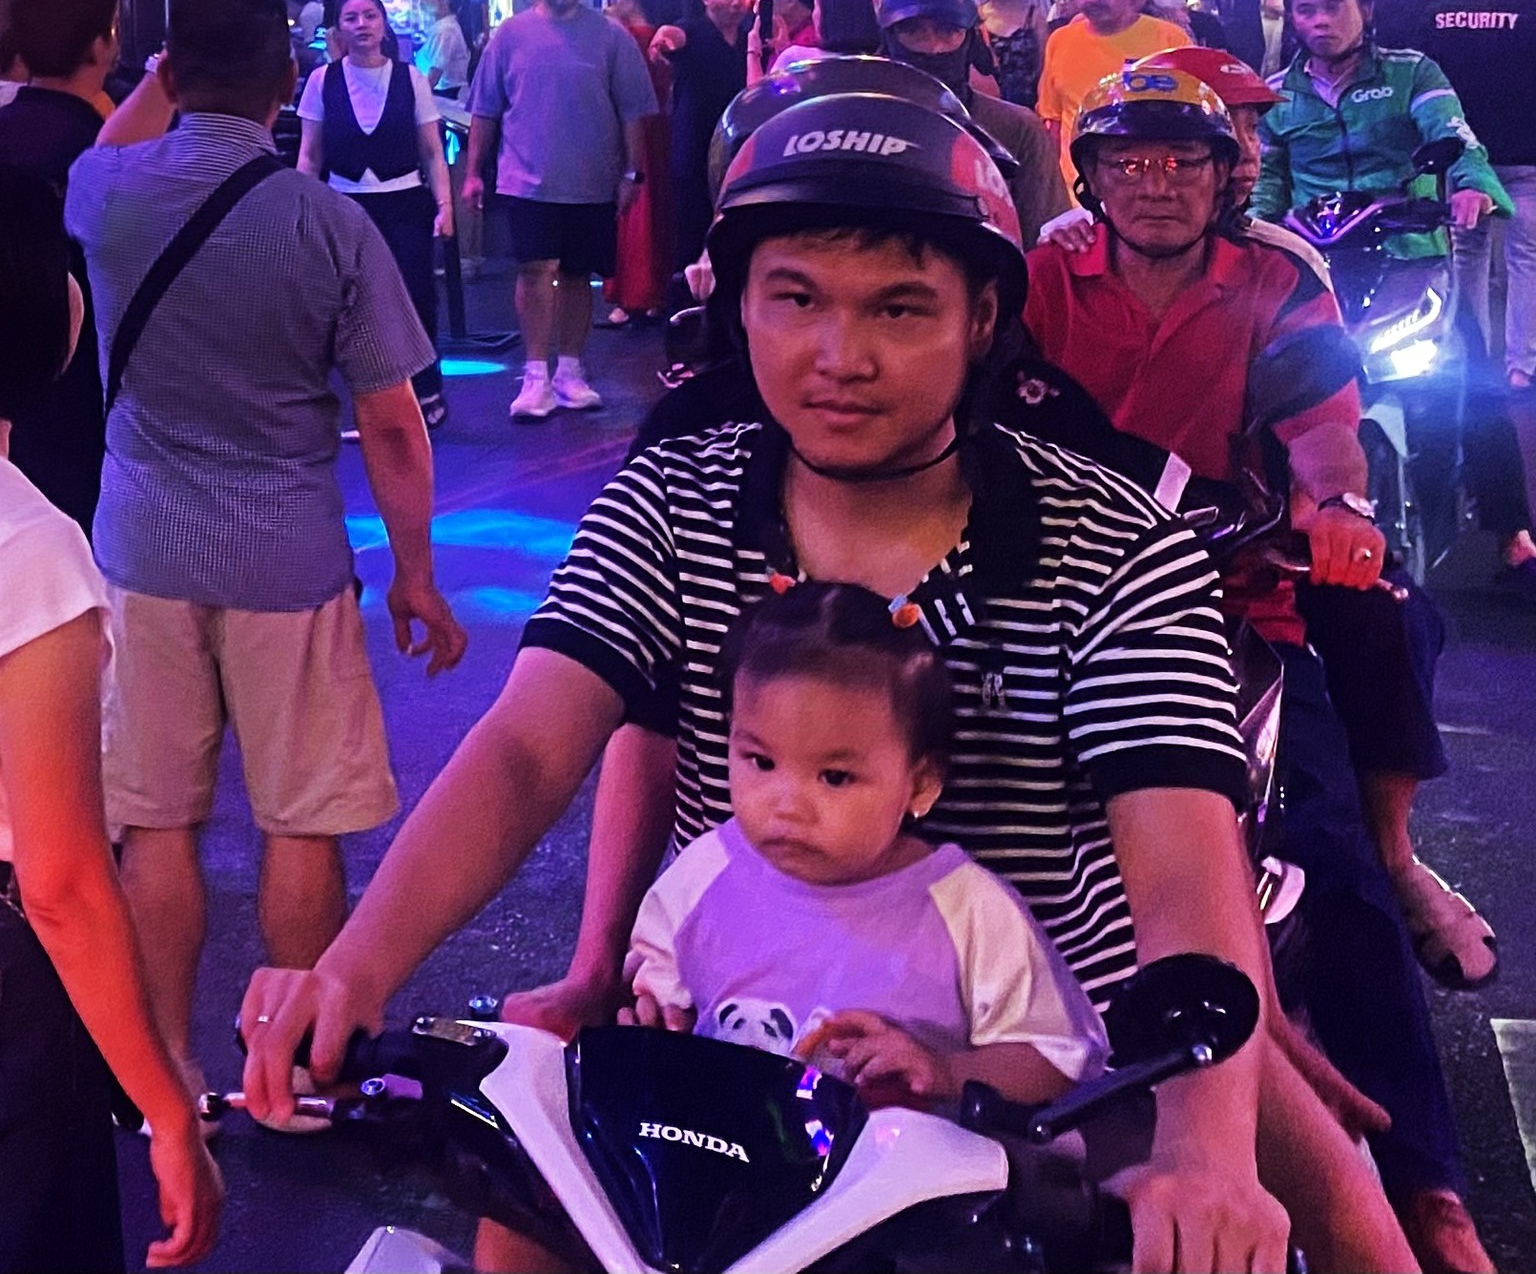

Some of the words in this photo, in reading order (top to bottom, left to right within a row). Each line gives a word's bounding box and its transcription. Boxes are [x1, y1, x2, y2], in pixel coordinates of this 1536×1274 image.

[1435, 11, 1519, 30] SECURITY
[1351, 86, 1394, 104] Grab
[638, 1121, 750, 1164] HONDA
